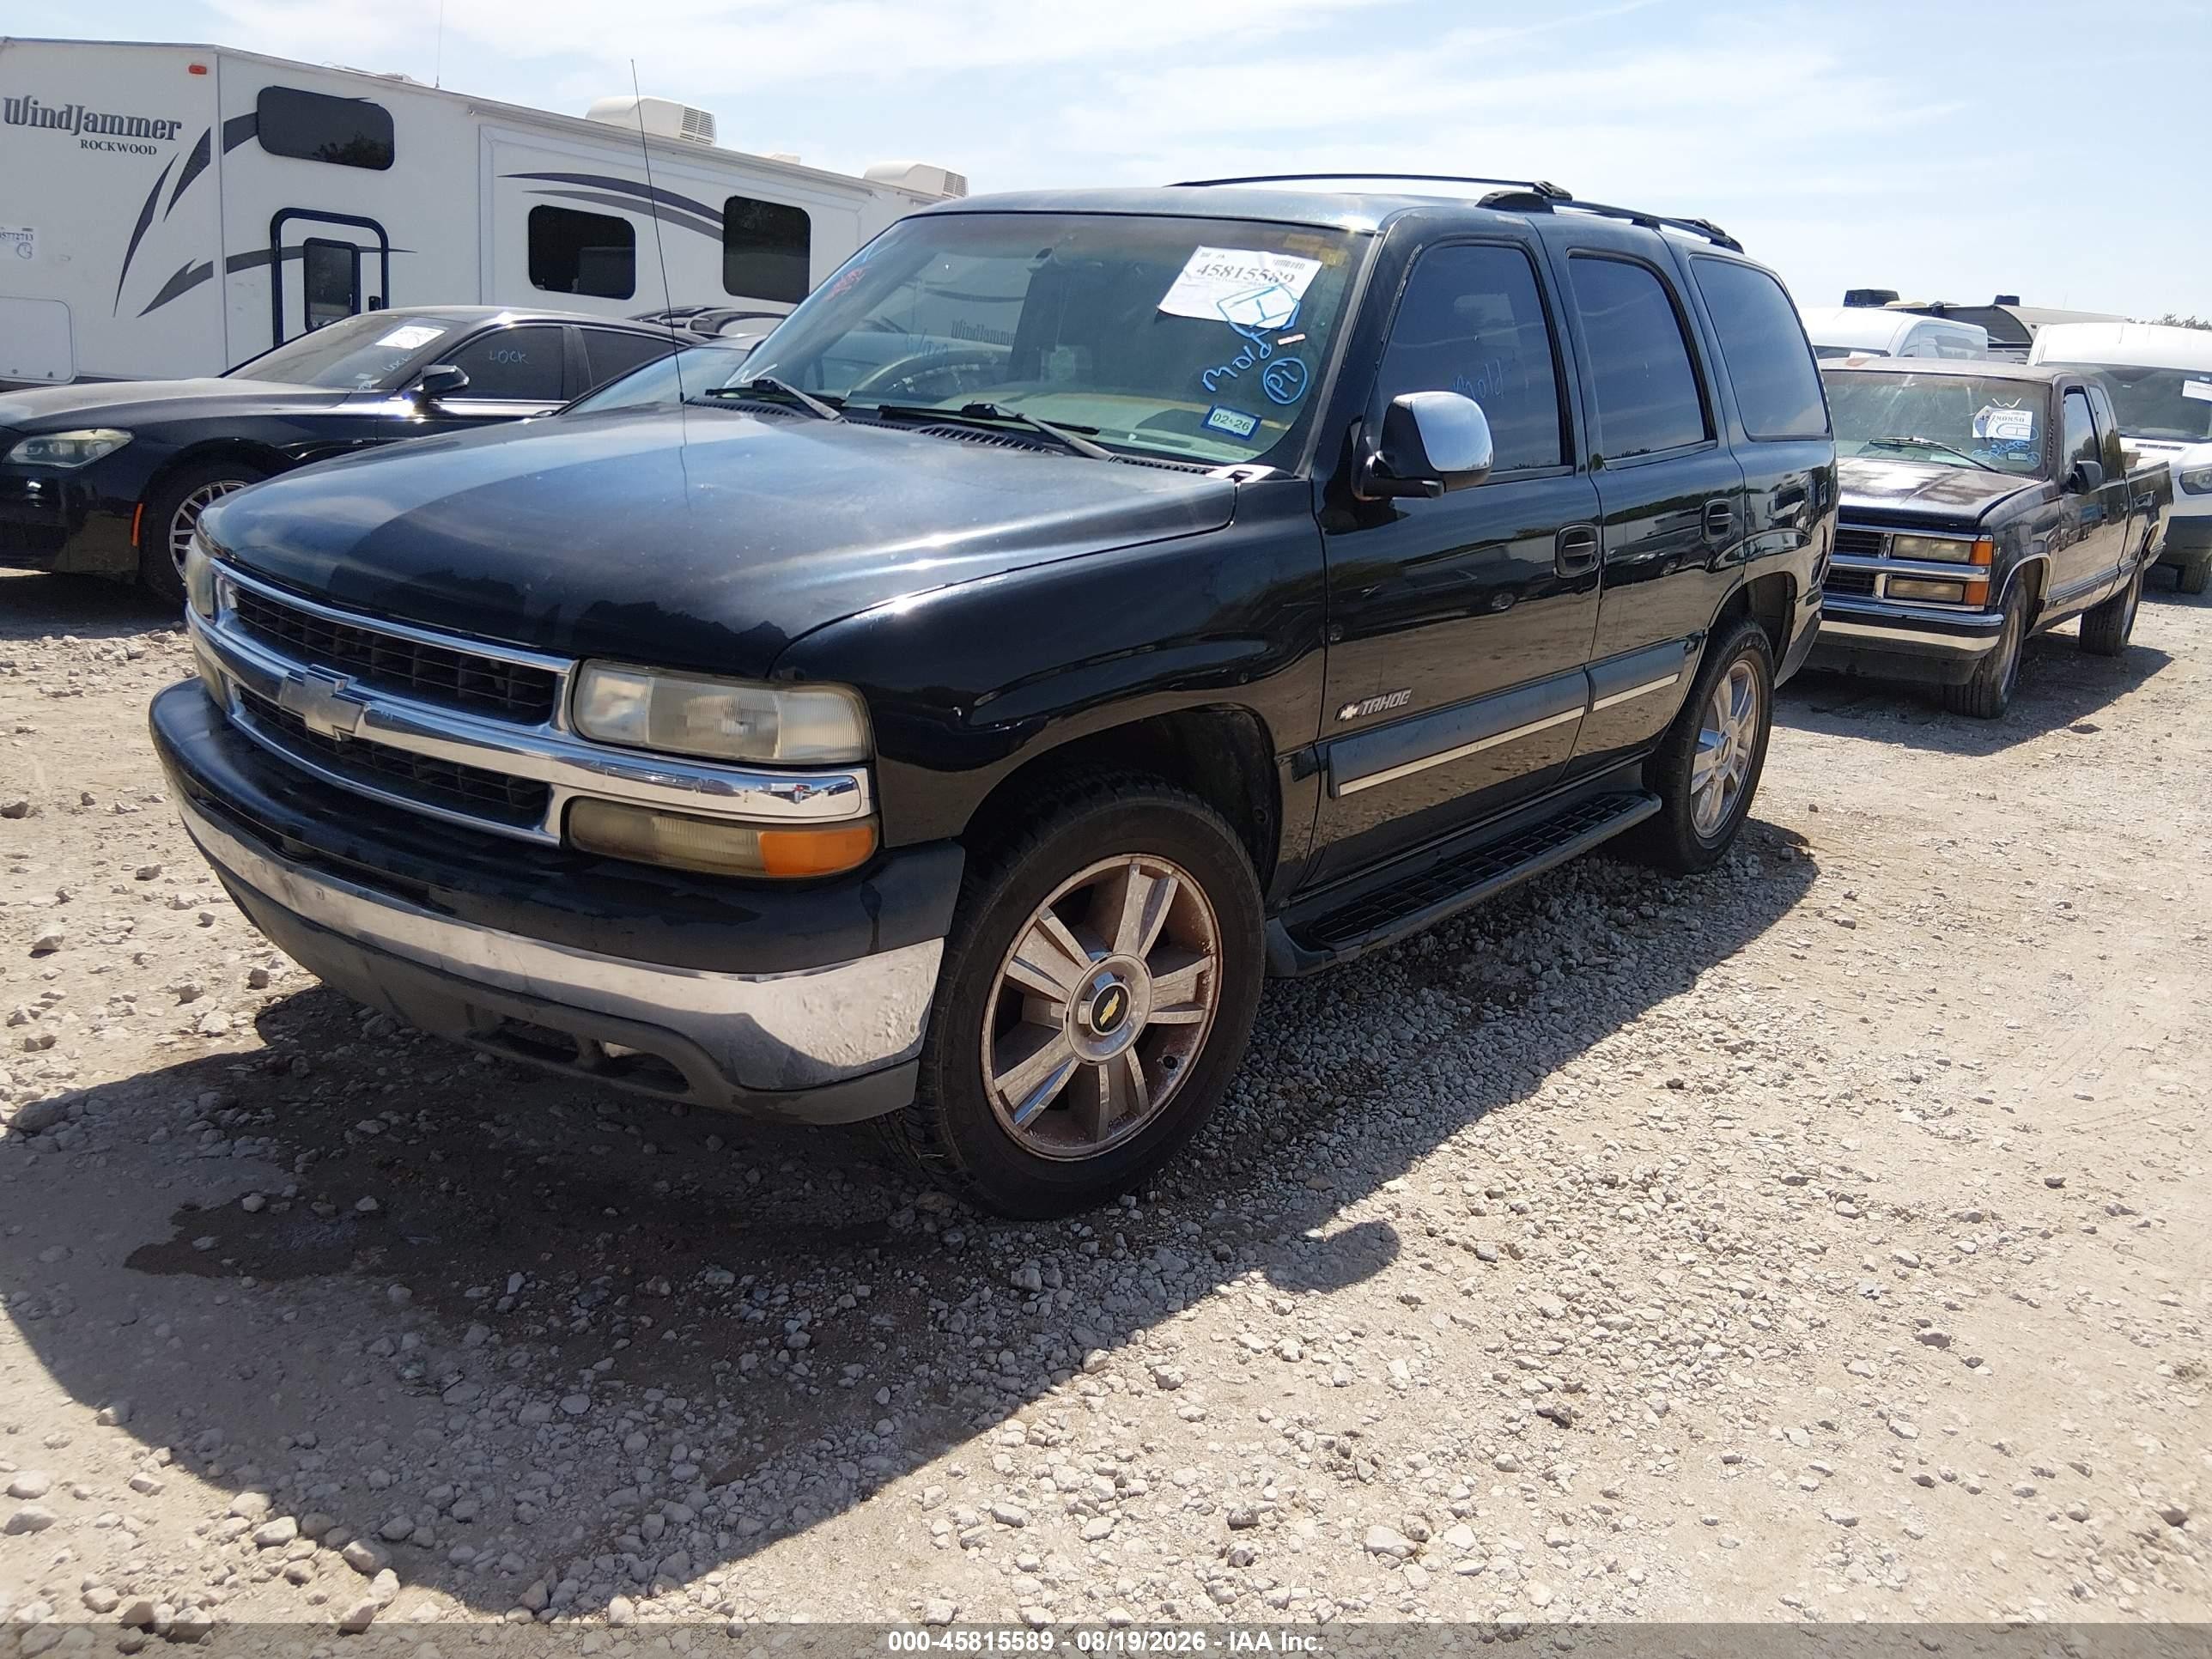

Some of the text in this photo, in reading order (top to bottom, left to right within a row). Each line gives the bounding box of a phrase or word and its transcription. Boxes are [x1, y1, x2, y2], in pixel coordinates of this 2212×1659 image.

[80, 139, 158, 155] ROCKWOOD
[0, 232, 34, 241] 5772713
[1196, 262, 1296, 283] 45815589
[1361, 688, 1413, 716] TAHOE
